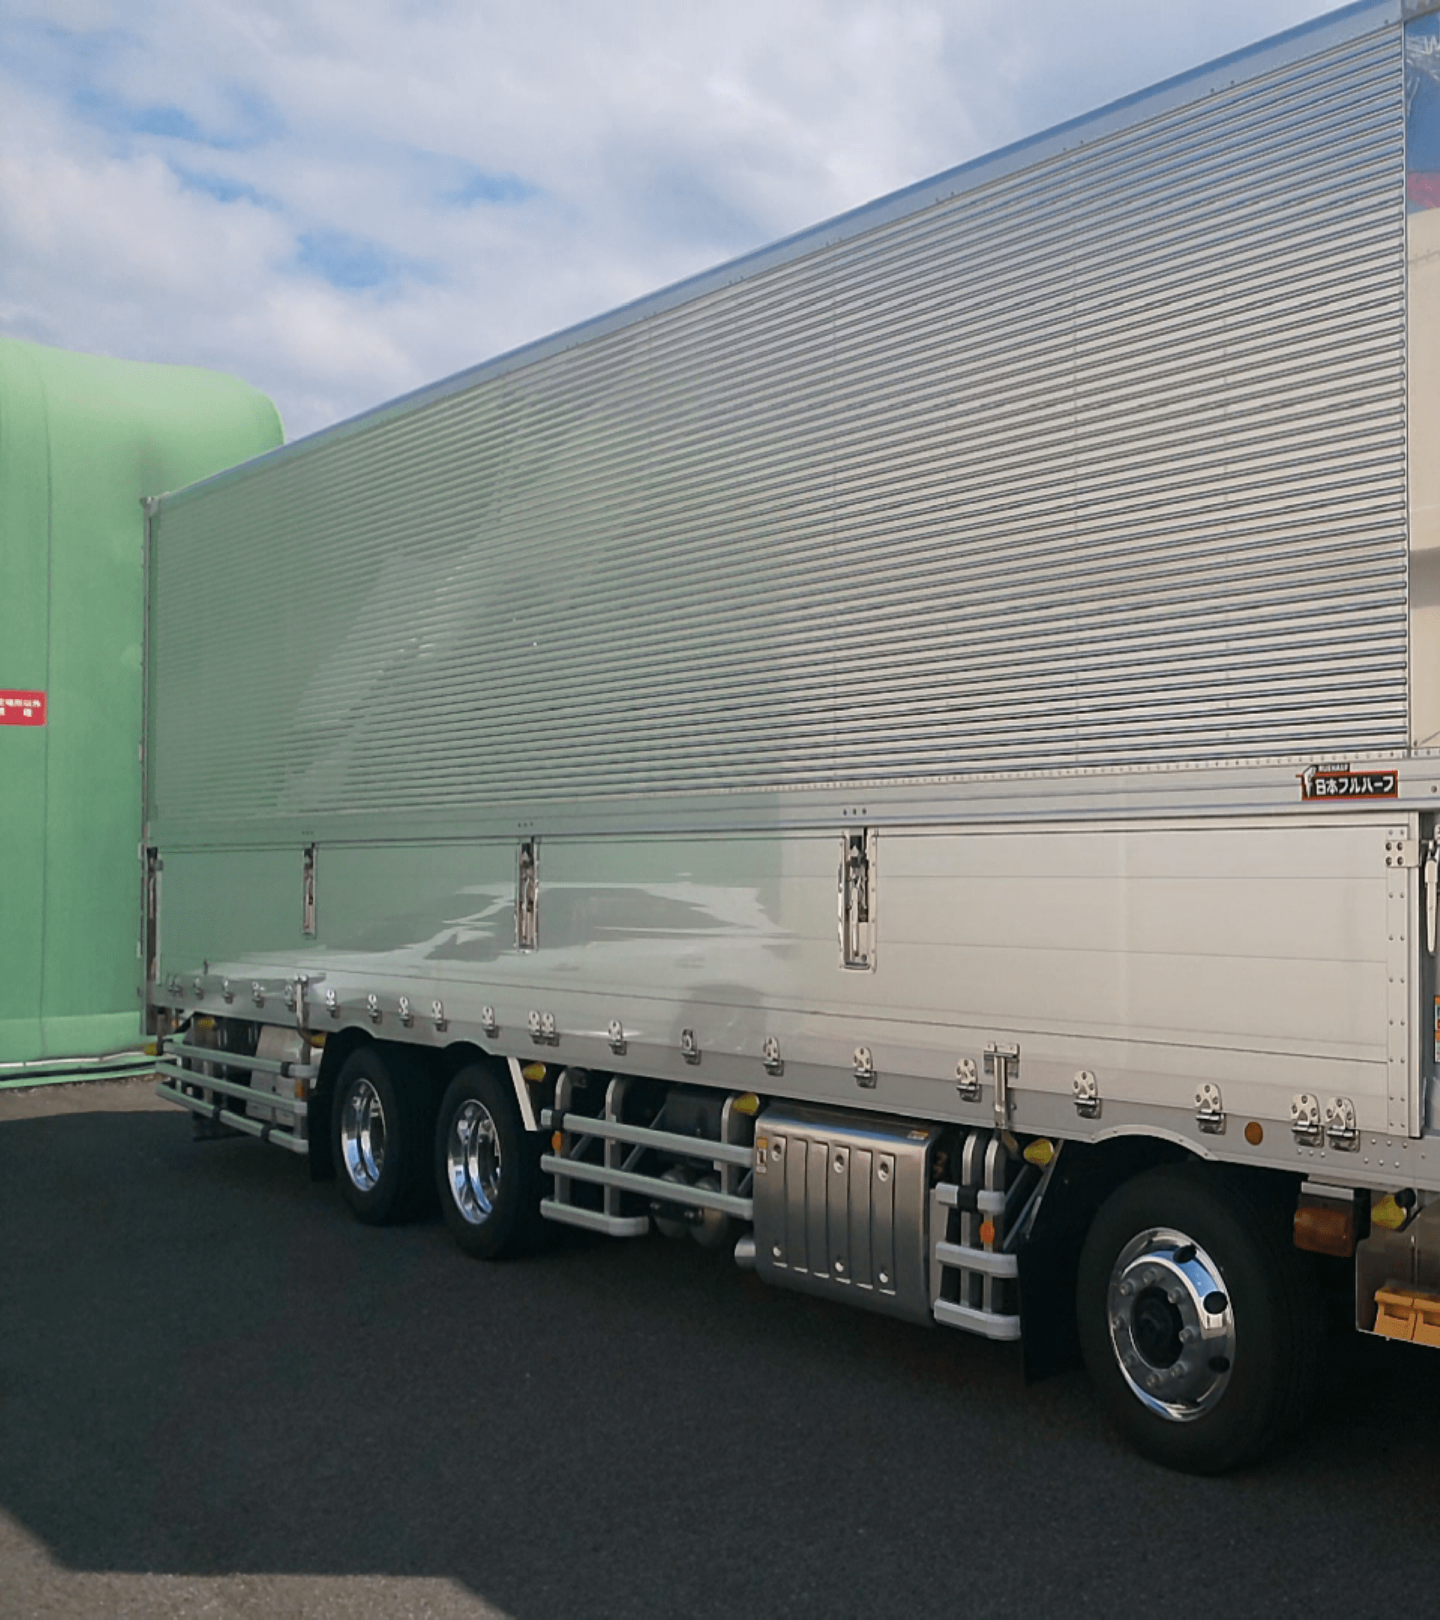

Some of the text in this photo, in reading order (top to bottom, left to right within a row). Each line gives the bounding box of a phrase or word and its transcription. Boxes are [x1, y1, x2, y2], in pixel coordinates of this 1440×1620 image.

[1315, 775, 1394, 796] 日本フルハーフ
